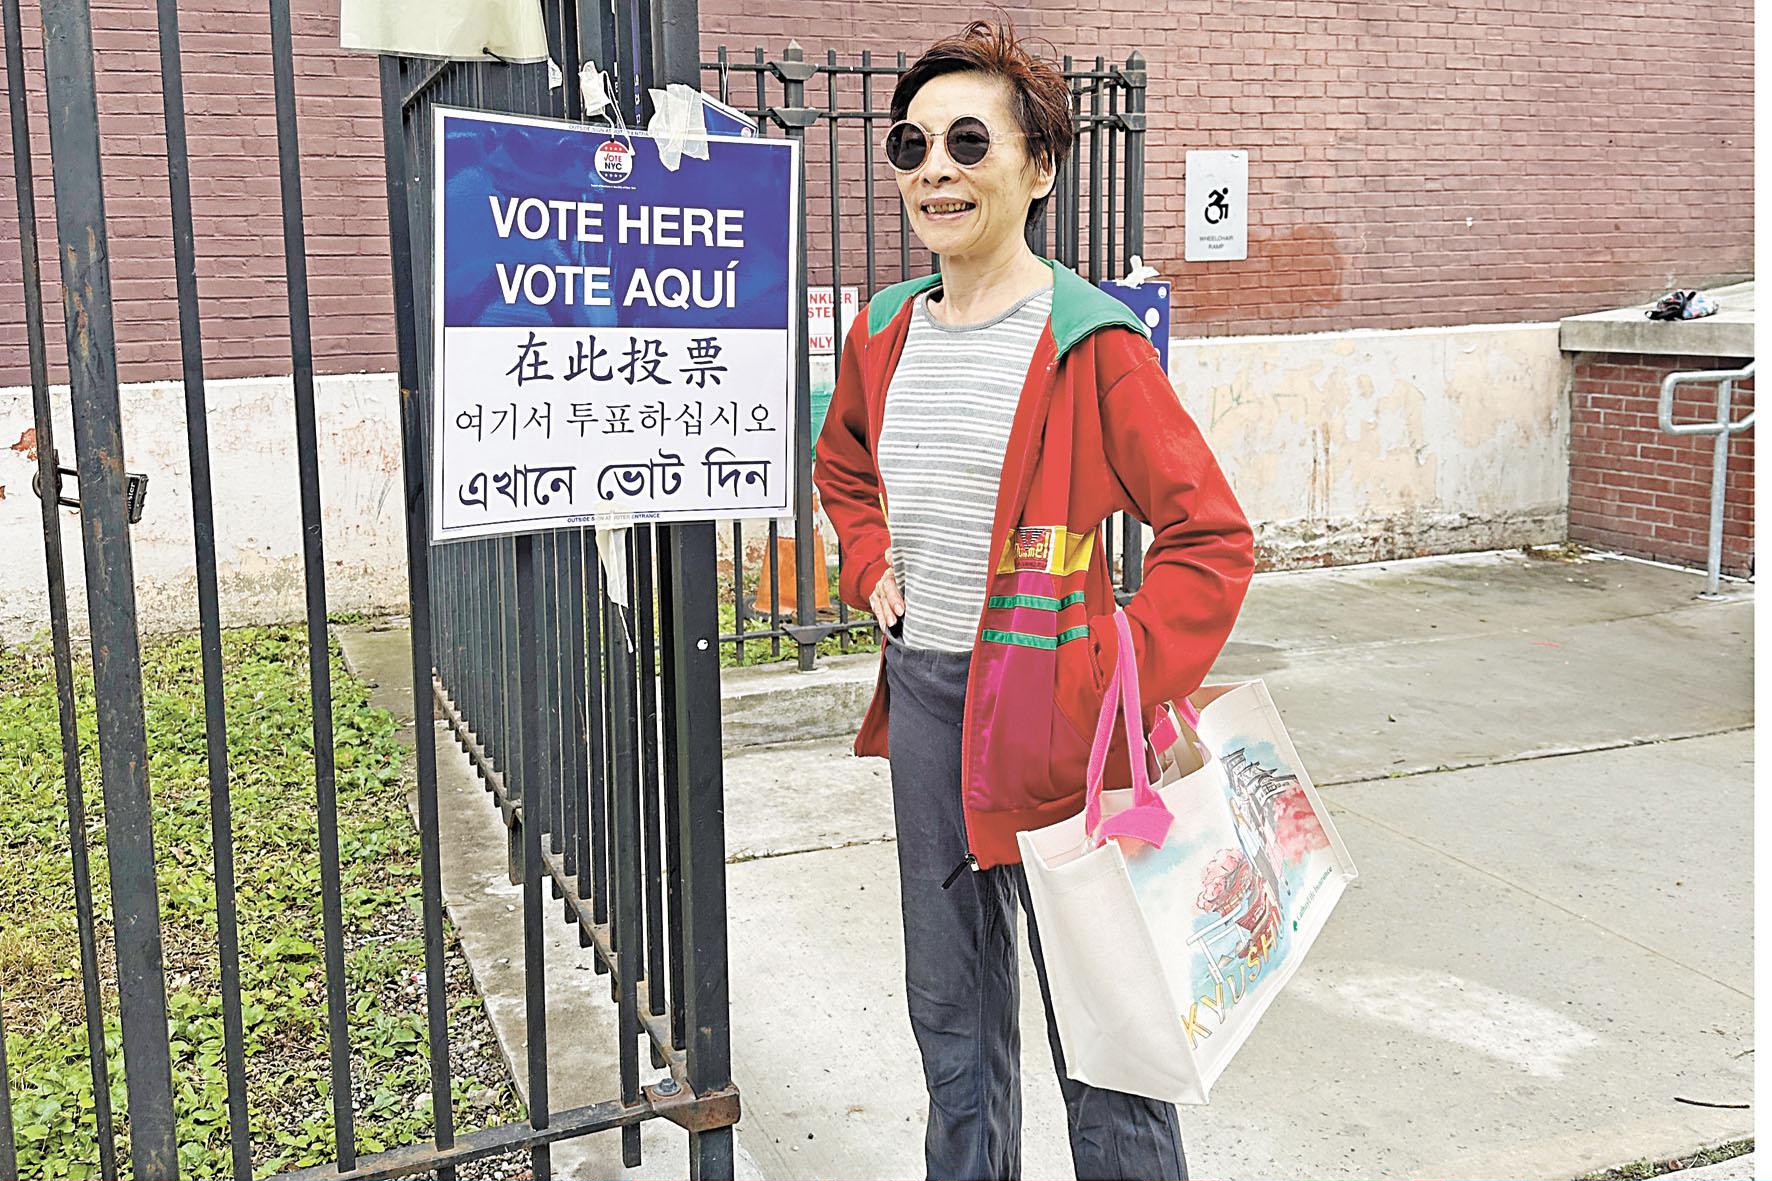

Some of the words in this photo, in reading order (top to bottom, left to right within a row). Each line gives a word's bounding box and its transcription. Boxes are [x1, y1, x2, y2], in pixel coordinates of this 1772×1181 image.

[604, 154, 622, 162] VOTE
[488, 195, 604, 243] VOTE
[618, 203, 745, 248] HERE
[495, 263, 611, 307] VOTE
[622, 260, 740, 311] AQUÍ
[505, 332, 729, 389] 在此投票
[809, 336, 833, 348] NLY
[456, 402, 552, 442] 여기서
[566, 400, 777, 437] 투표하십시오
[459, 464, 577, 511] এখানে
[597, 448, 685, 501] ভোট
[702, 446, 771, 498] দিন
